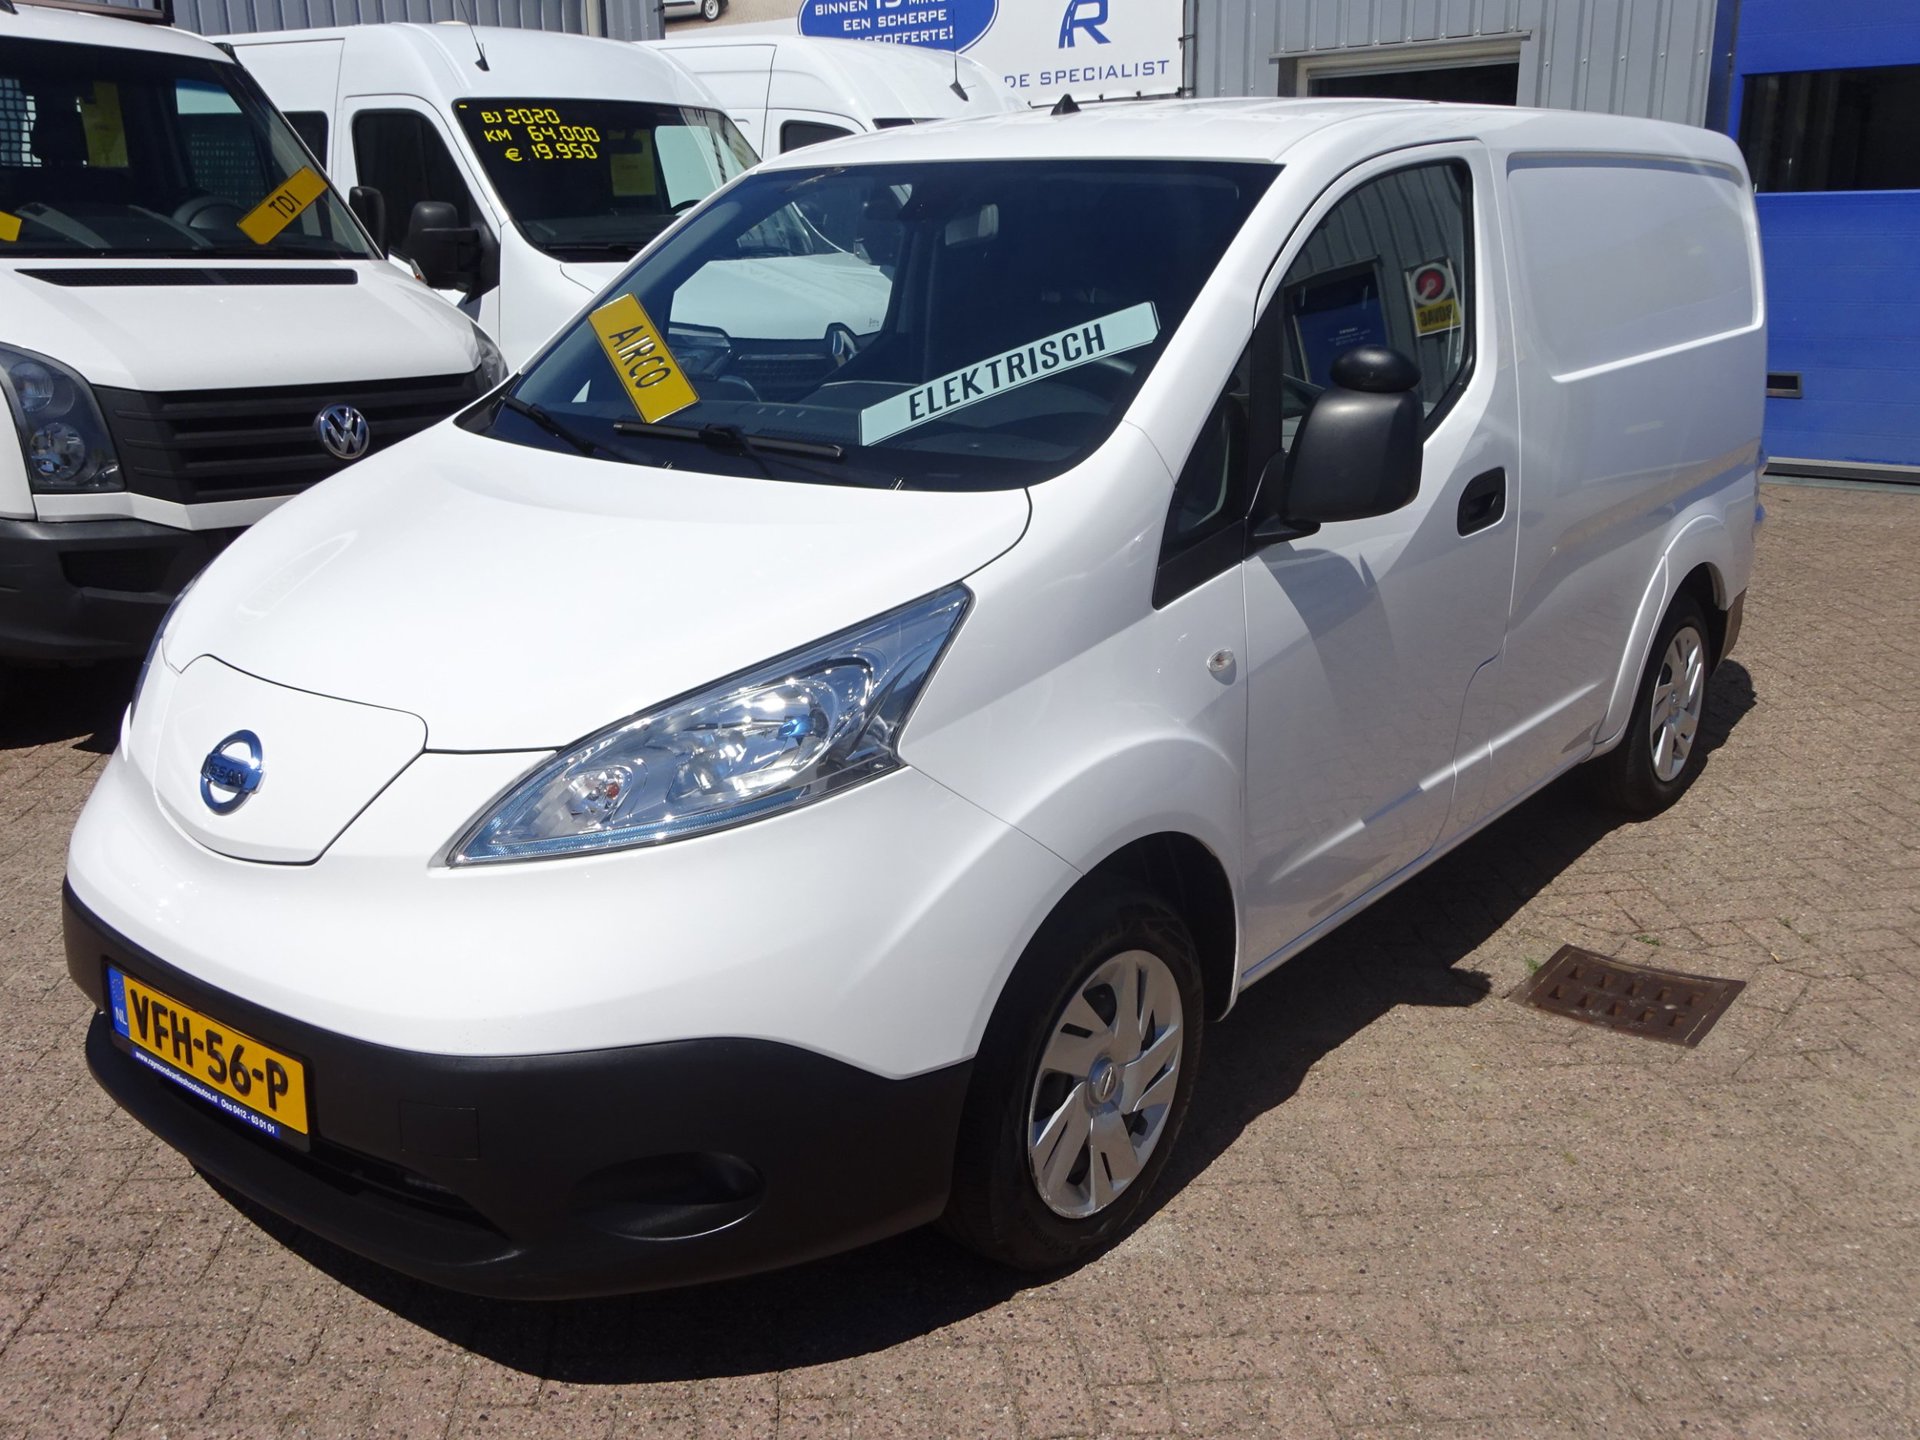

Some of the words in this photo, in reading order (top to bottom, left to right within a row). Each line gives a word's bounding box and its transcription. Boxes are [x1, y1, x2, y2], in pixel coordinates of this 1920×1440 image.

[815, 0, 868, 16] BINNEN
[843, 18, 871, 32] EEN
[877, 9, 947, 28] SCHERPE
[1004, 73, 1030, 89] DE
[1040, 59, 1170, 86] SPECIALIST
[504, 108, 561, 124] 2020
[484, 129, 513, 142] KM
[527, 126, 600, 142] 64.000
[505, 148, 522, 161] €
[531, 143, 598, 159] 19.950
[268, 189, 302, 219] TDI
[608, 325, 671, 388] AIRCO
[909, 322, 1107, 422] ELEKTRISCH
[115, 1006, 128, 1025] NL
[130, 988, 289, 1112] VFH-56-P
